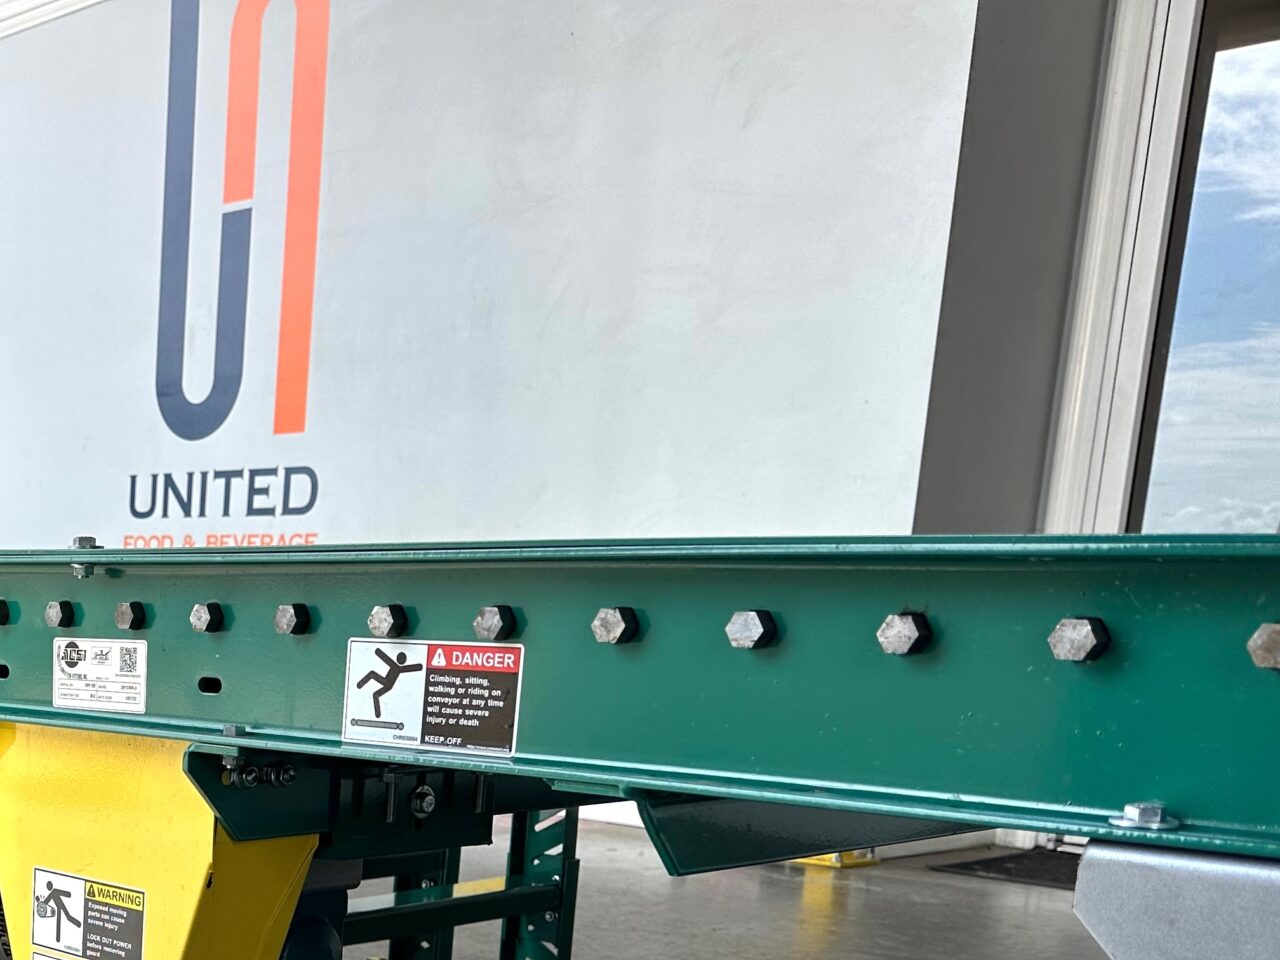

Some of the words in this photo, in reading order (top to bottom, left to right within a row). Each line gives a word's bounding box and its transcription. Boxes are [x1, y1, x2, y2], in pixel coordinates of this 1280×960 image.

[129, 464, 319, 520] UNITED
[123, 534, 174, 549] FOOD
[182, 534, 196, 548] &
[452, 651, 515, 668] DANGER
[429, 674, 462, 684] Climbing,
[465, 676, 490, 686] sitting,
[428, 685, 455, 695] walking
[468, 687, 489, 697] riding
[427, 696, 460, 705] conveyor
[472, 699, 485, 707] any
[488, 699, 504, 707] time
[427, 705, 439, 713] will
[426, 715, 446, 725] injury
[459, 718, 479, 726] death
[424, 735, 444, 743] KEEP
[446, 737, 462, 745] OFF
[97, 887, 141, 907] WARNING
[88, 902, 108, 912] Exposed
[87, 933, 101, 942] LOCK
[102, 936, 112, 944] OUT
[113, 939, 132, 950] POWER
